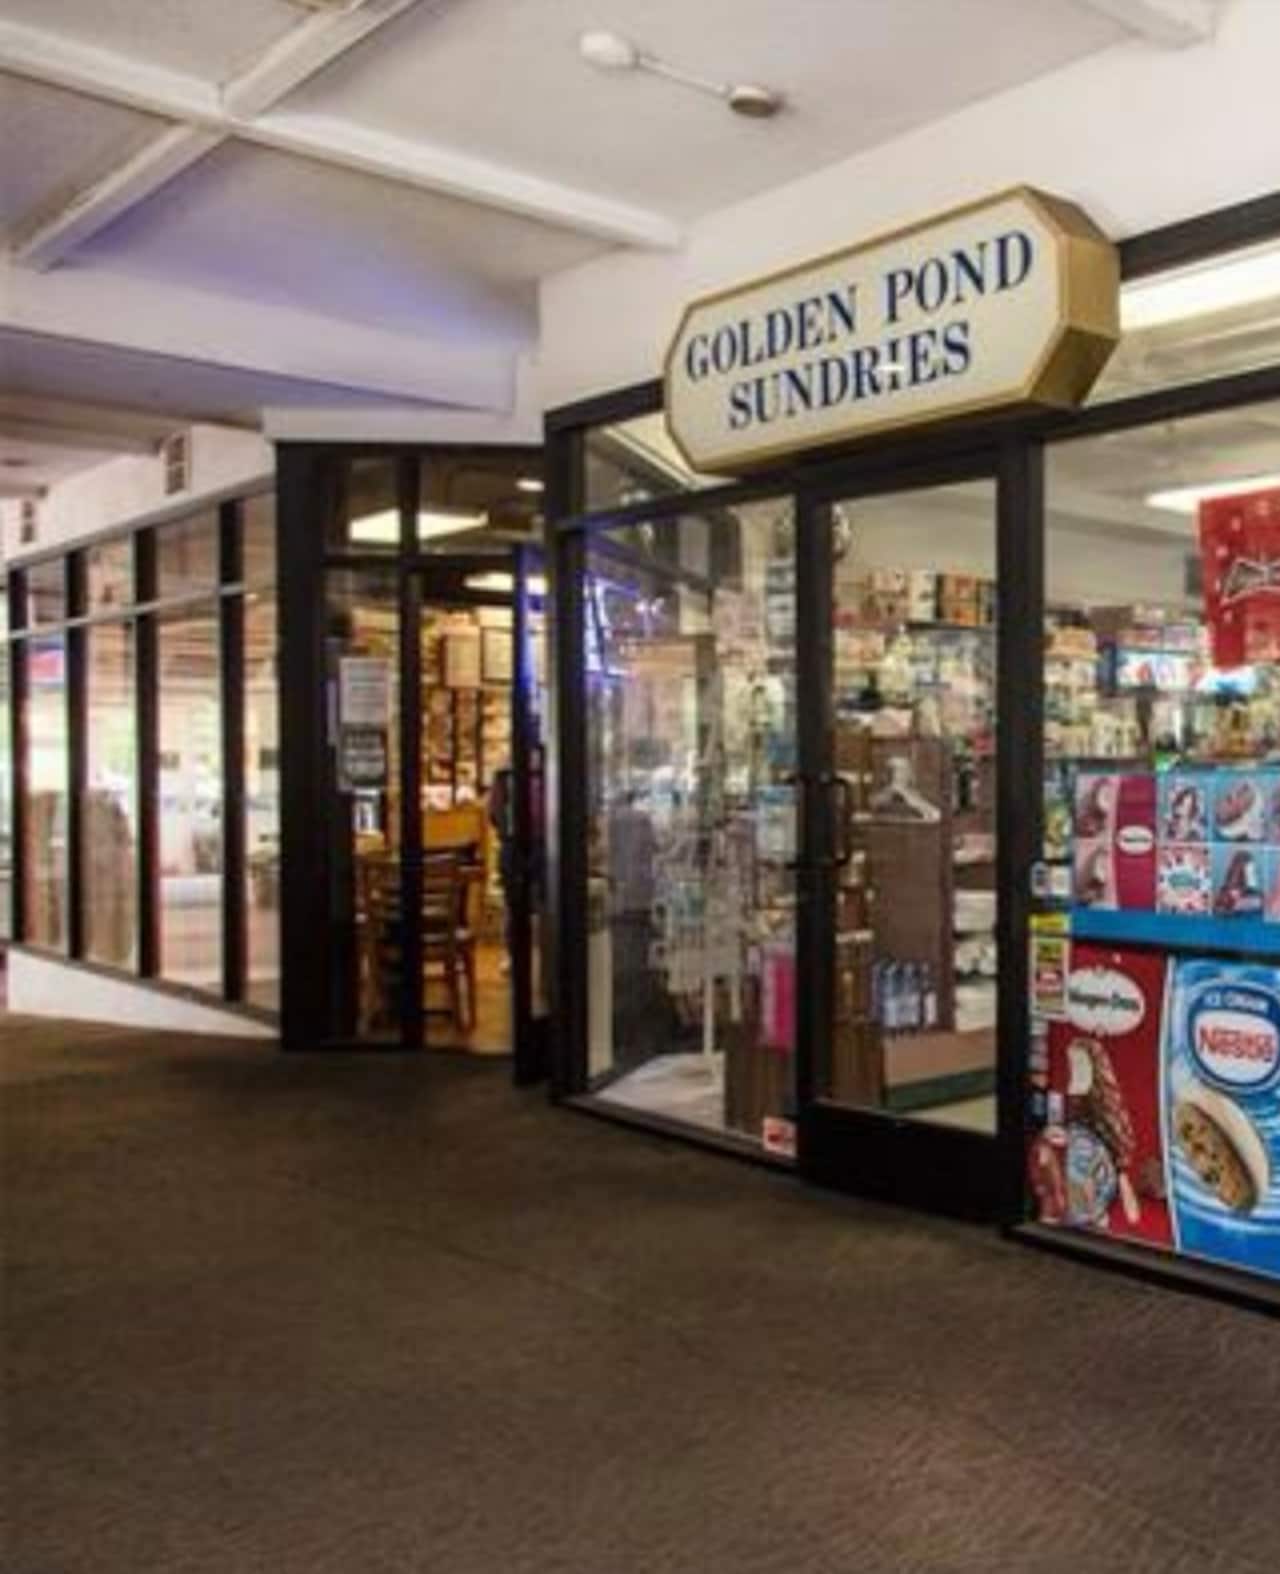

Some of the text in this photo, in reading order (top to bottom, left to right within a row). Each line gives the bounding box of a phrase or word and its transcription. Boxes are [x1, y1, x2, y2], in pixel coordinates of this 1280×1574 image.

[686, 230, 1033, 382] GOLDEN POND
[729, 321, 972, 431] SUNDRIES
